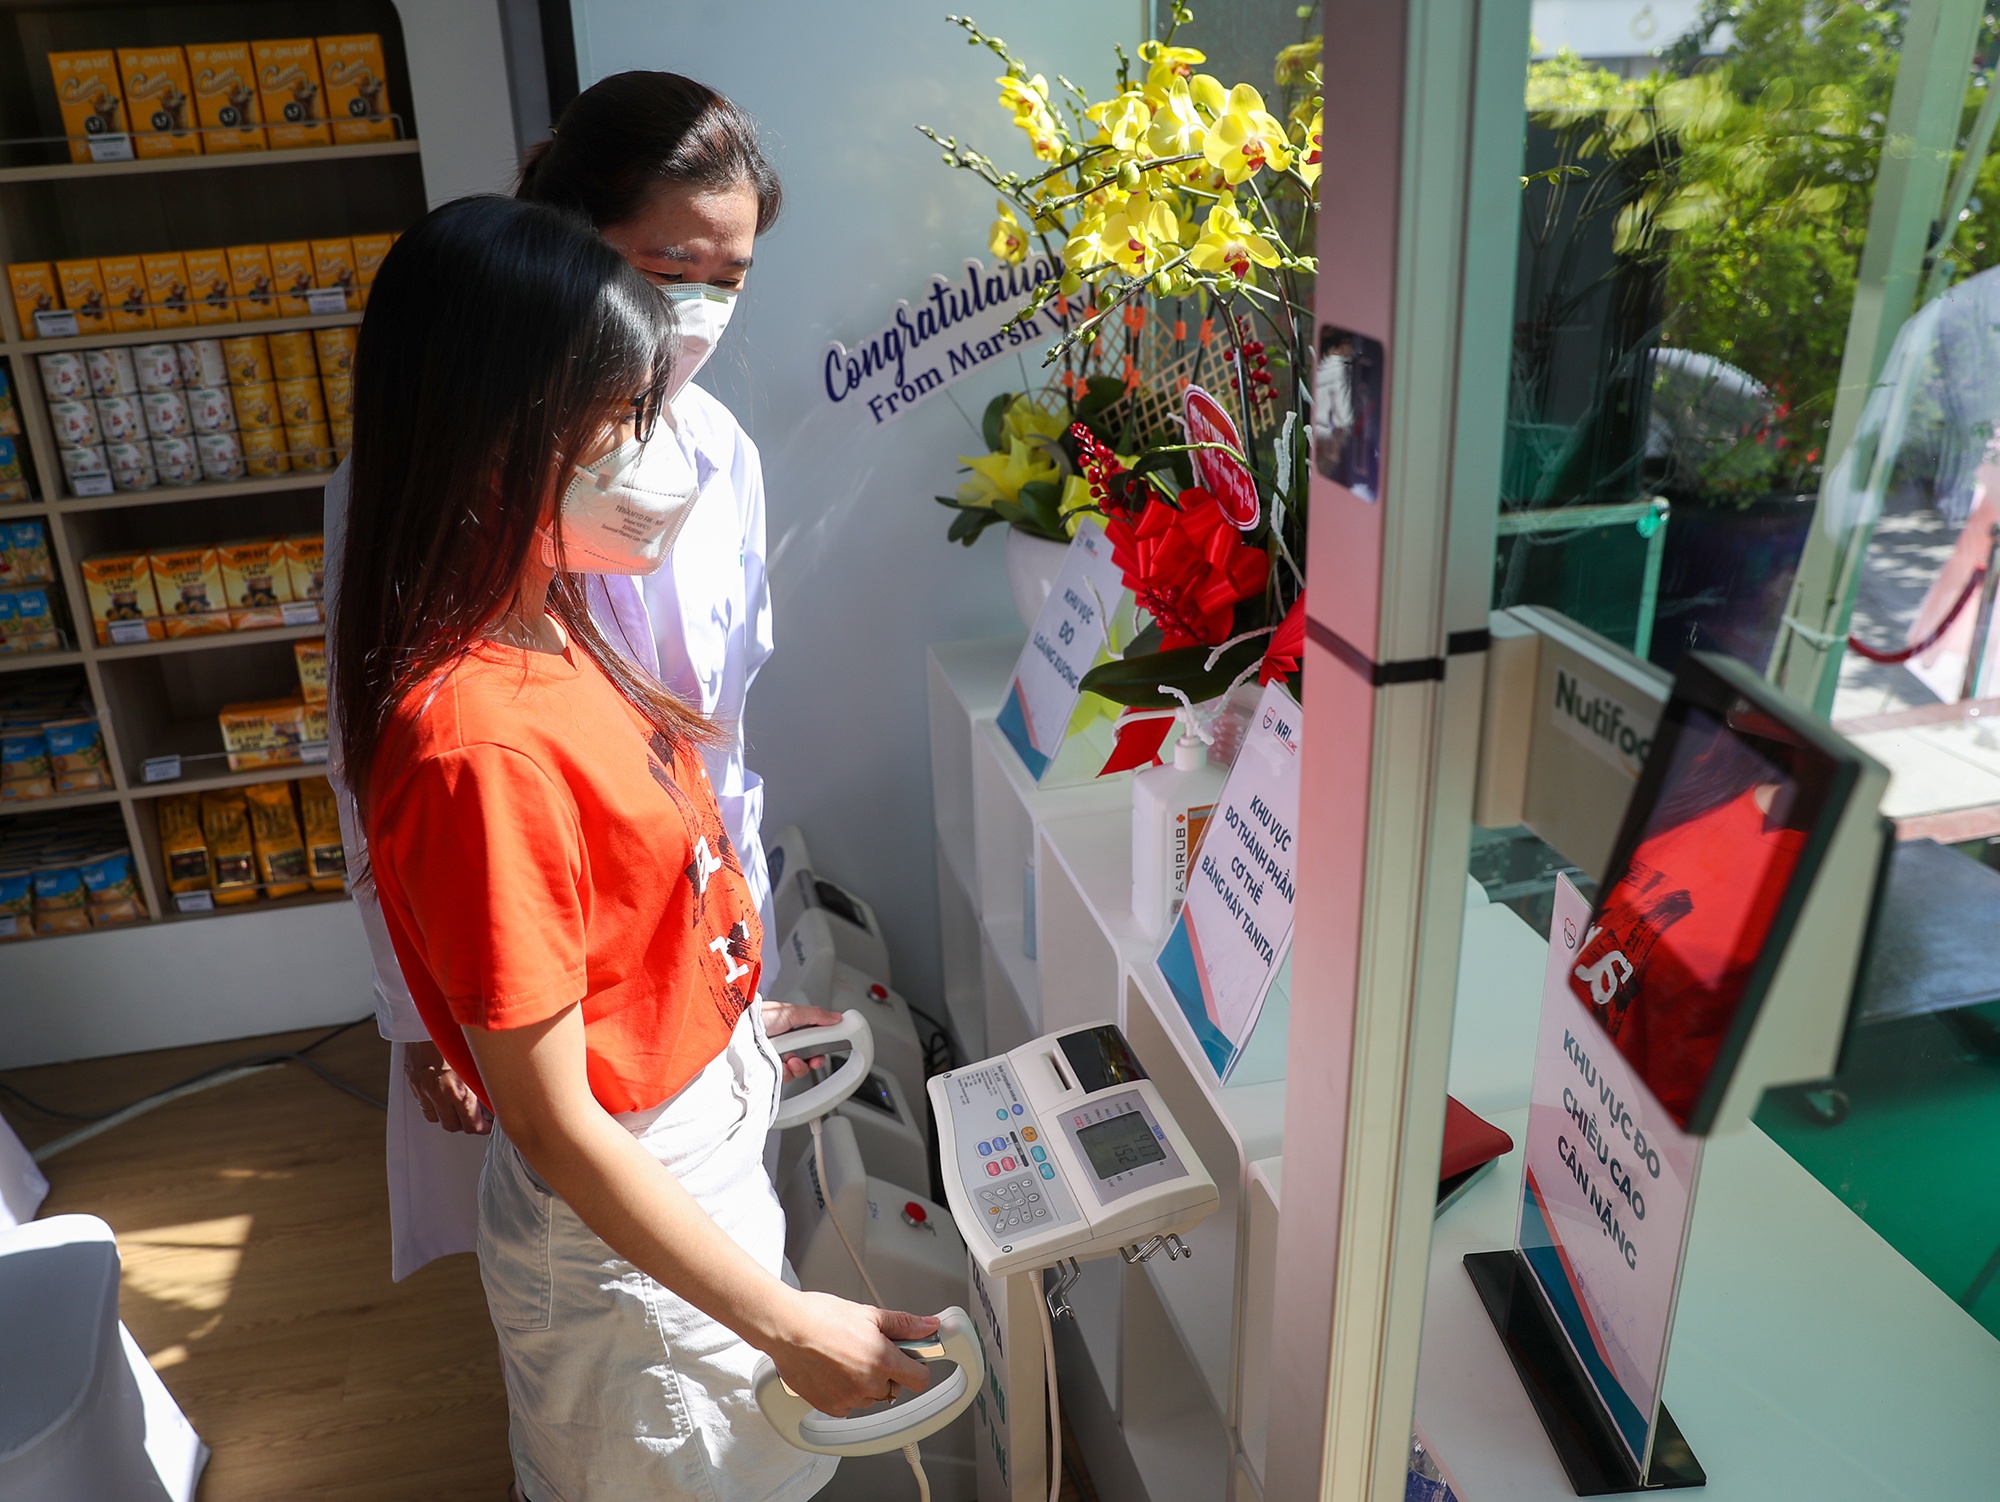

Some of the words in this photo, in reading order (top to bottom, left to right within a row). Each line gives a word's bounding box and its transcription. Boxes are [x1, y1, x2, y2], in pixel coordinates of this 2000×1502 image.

[867, 367, 944, 425] From
[947, 317, 1042, 377] Marsh
[615, 505, 644, 520] TENAMYD
[1064, 588, 1079, 610] KHU
[1058, 620, 1075, 646] ĐO
[1275, 718, 1292, 742] NRI
[1225, 805, 1240, 828] ĐO
[1238, 823, 1267, 869] THÀNH
[1266, 861, 1296, 904] PHẦN
[1249, 795, 1271, 826] KHU
[1270, 821, 1292, 853] VỰC
[1175, 826, 1185, 893] ASIRUB
[1230, 856, 1248, 882] CƠ
[1244, 871, 1264, 905] THỂ
[1201, 854, 1226, 899] BẰNG
[1223, 888, 1244, 921] MÁY
[1241, 914, 1273, 968] TANITA
[1563, 1029, 1597, 1088] KHU
[1598, 1075, 1632, 1141] VỰC
[1633, 1128, 1660, 1179] ĐO
[1562, 1087, 1609, 1165] CHIỀU
[1610, 1157, 1645, 1221] CAO
[1590, 1183, 1637, 1271] NẶNG
